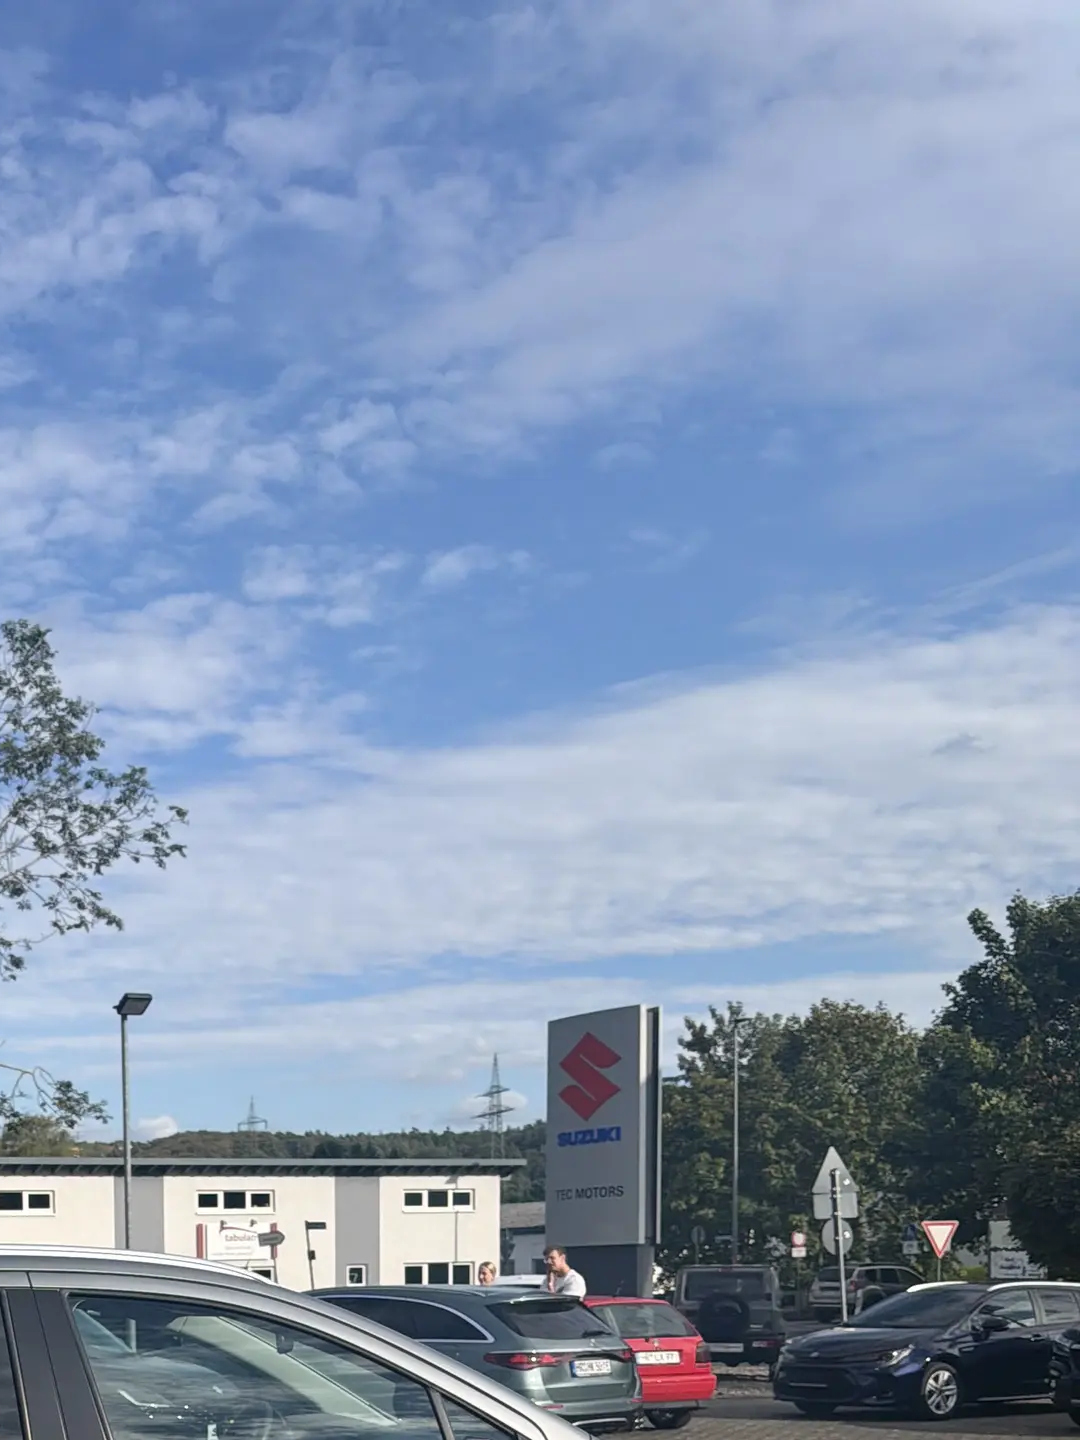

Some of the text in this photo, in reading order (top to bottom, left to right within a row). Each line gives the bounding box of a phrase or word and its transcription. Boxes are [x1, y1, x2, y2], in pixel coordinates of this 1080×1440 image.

[557, 1126, 622, 1148] SUZUKI
[555, 1185, 625, 1201] TEC MOTORS
